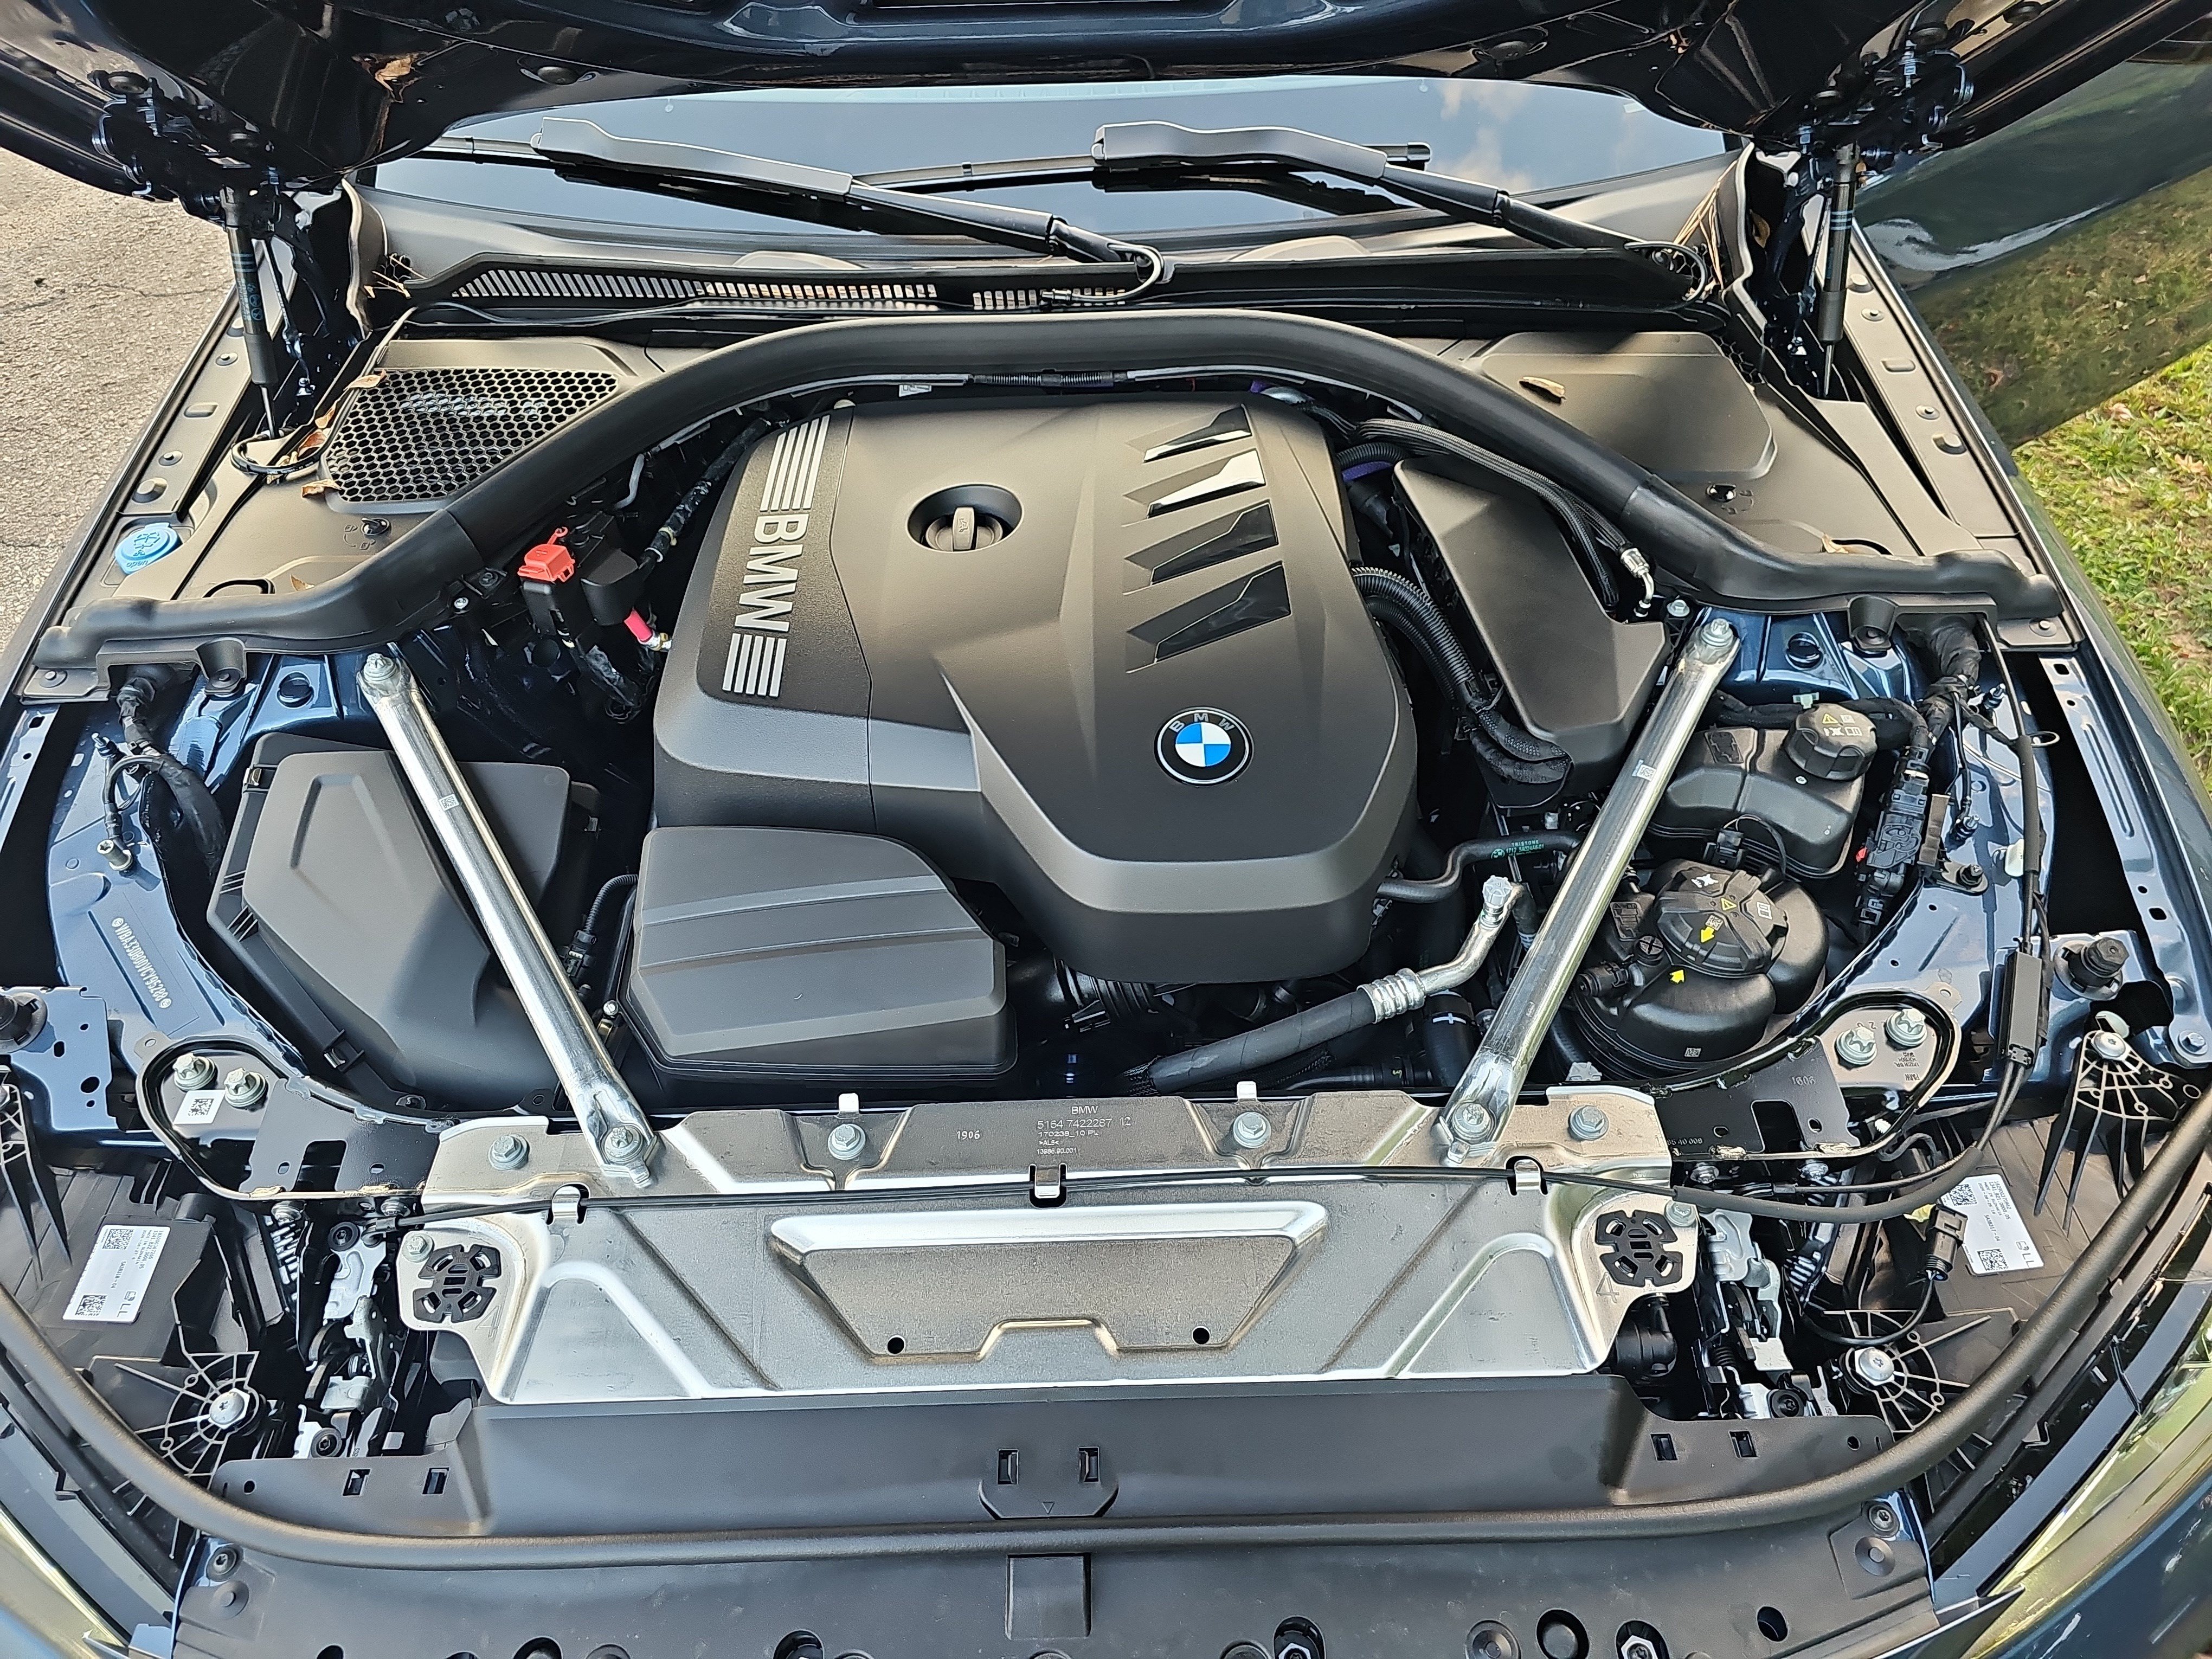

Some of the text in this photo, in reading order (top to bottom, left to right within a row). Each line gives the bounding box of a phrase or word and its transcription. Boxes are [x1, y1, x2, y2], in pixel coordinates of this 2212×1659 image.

[126, 560, 149, 568] open
[735, 513, 809, 632] BMW
[1169, 713, 1235, 732] BMW
[1071, 1105, 1099, 1115] BMW
[1037, 1116, 1131, 1129] 5164 7422287 12
[956, 1130, 981, 1141] 1906
[117, 1303, 131, 1317] LL
